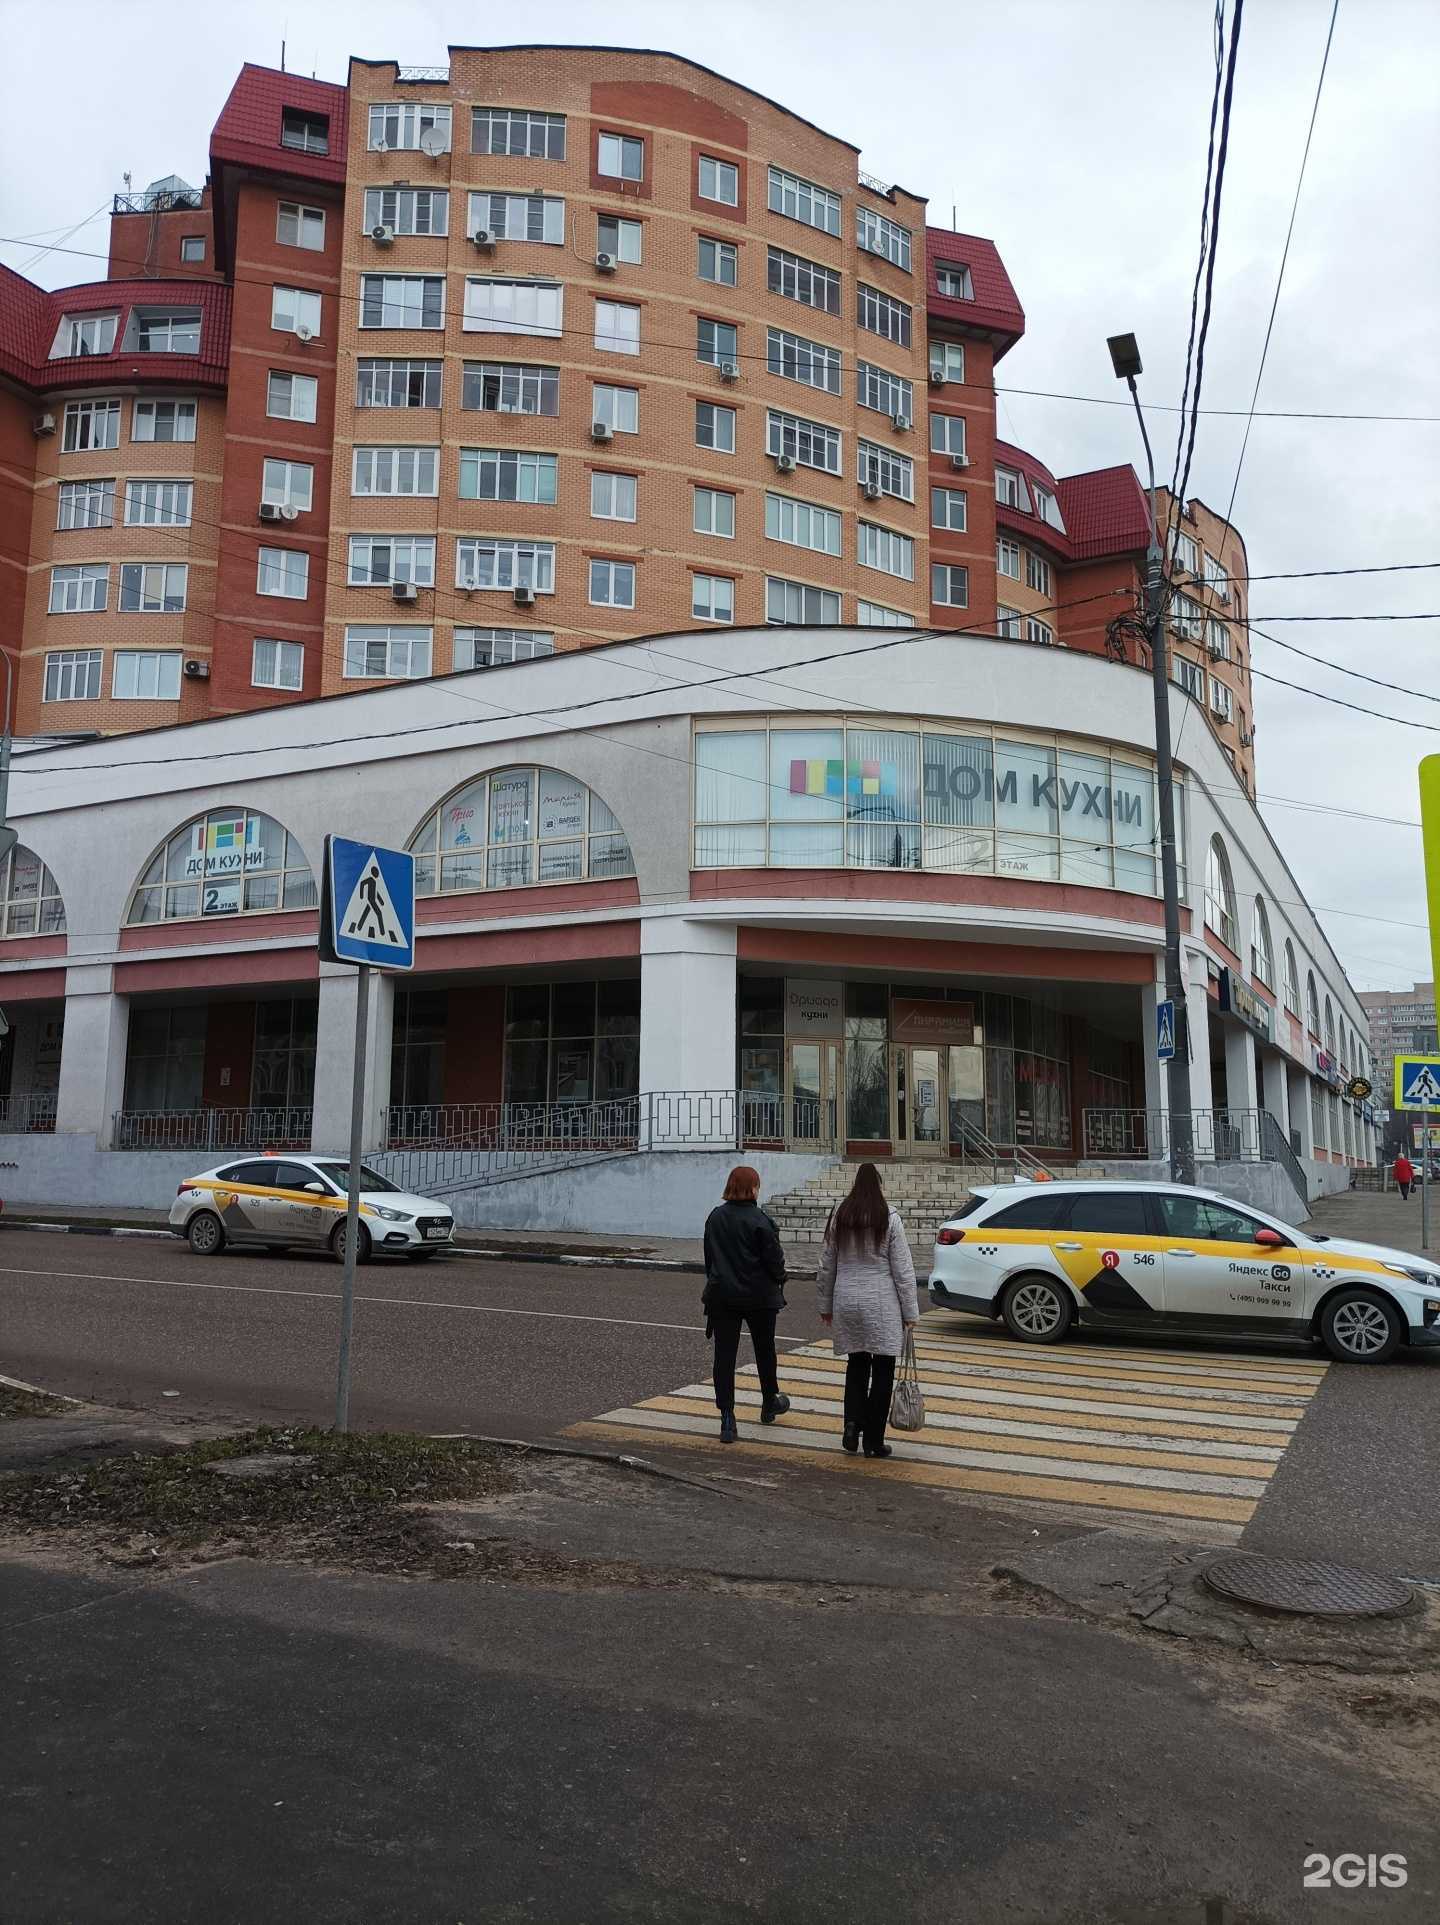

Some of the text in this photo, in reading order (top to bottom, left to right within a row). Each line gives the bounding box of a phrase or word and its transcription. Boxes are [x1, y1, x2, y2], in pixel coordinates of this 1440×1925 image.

[493, 780, 528, 793] Шатура
[923, 762, 1143, 828] ДОМ КУХНИ
[187, 850, 263, 876] ДОМ КУХНИ
[1000, 860, 1029, 871] ЭТАЖ
[206, 889, 219, 911] 2
[1105, 1254, 1114, 1266] Я
[1133, 1253, 1155, 1266] 546
[1228, 1263, 1289, 1279] Яндекс Go
[1259, 1279, 1291, 1293] Такси
